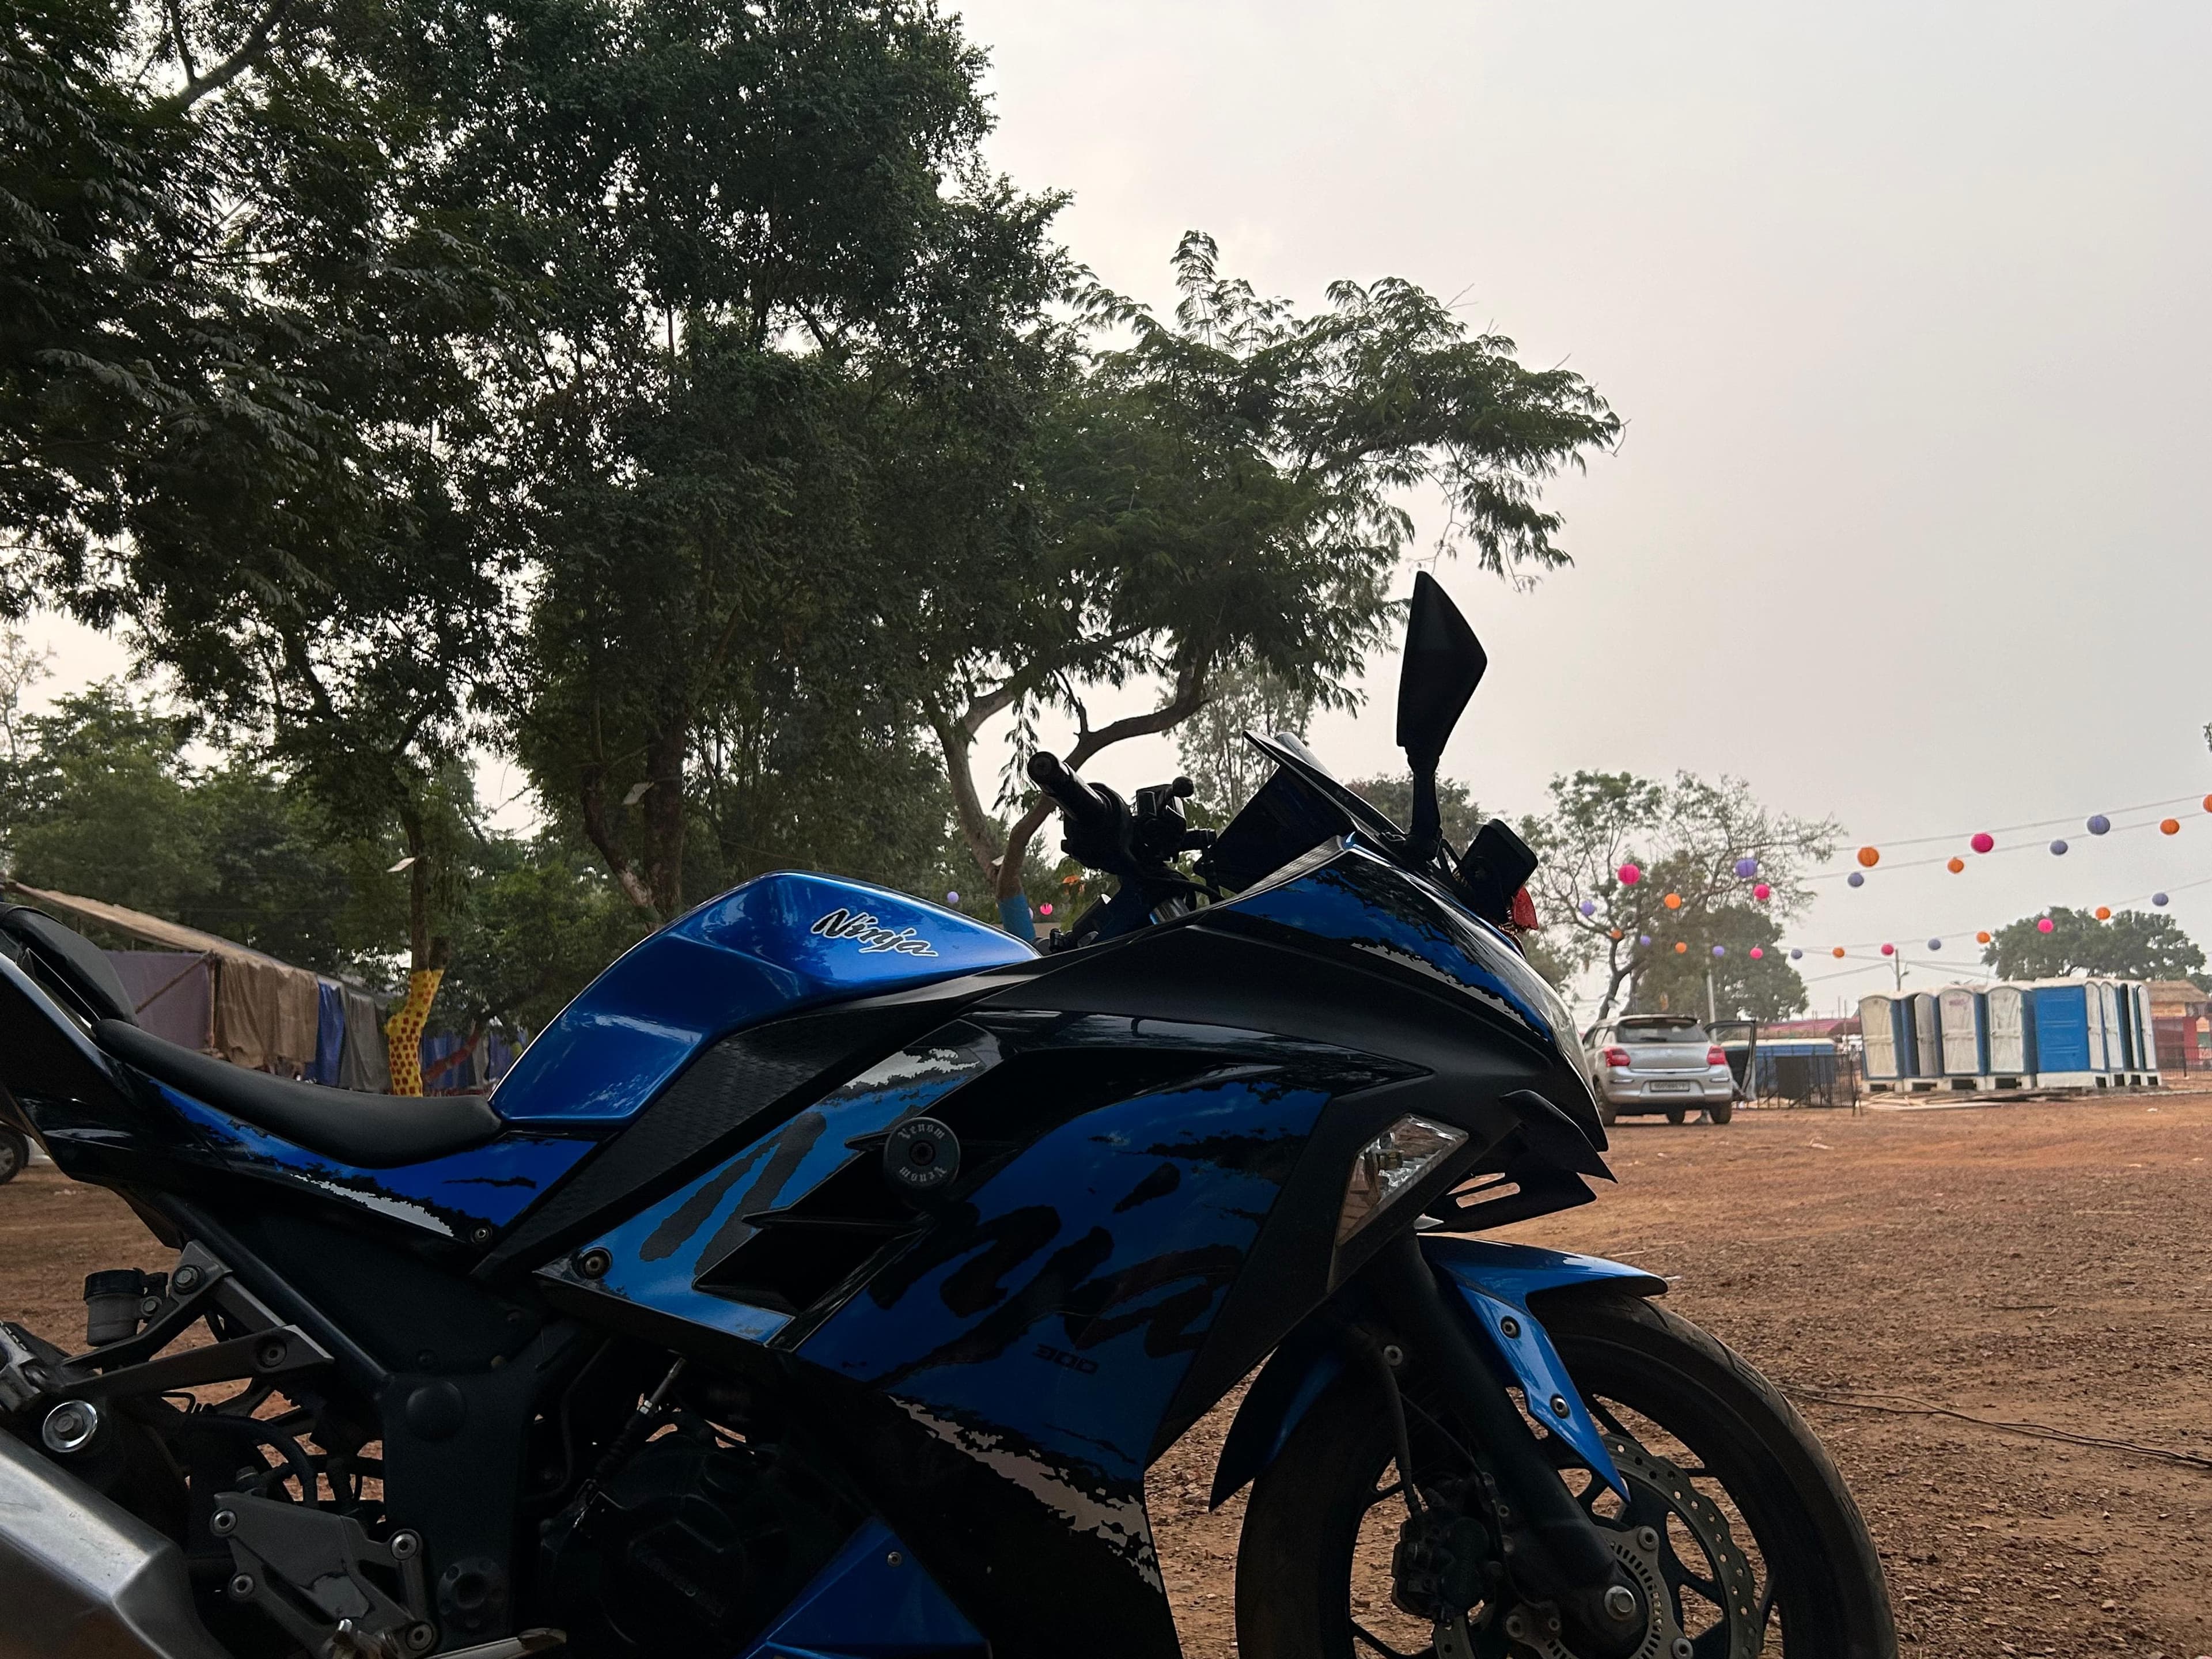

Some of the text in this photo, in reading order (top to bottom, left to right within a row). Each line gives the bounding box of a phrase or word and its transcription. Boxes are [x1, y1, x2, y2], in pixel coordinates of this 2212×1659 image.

[810, 907, 939, 957] Ninja
[897, 1123, 945, 1139] Venom
[899, 1166, 948, 1183] Venom
[1032, 1343, 1099, 1374] 300
